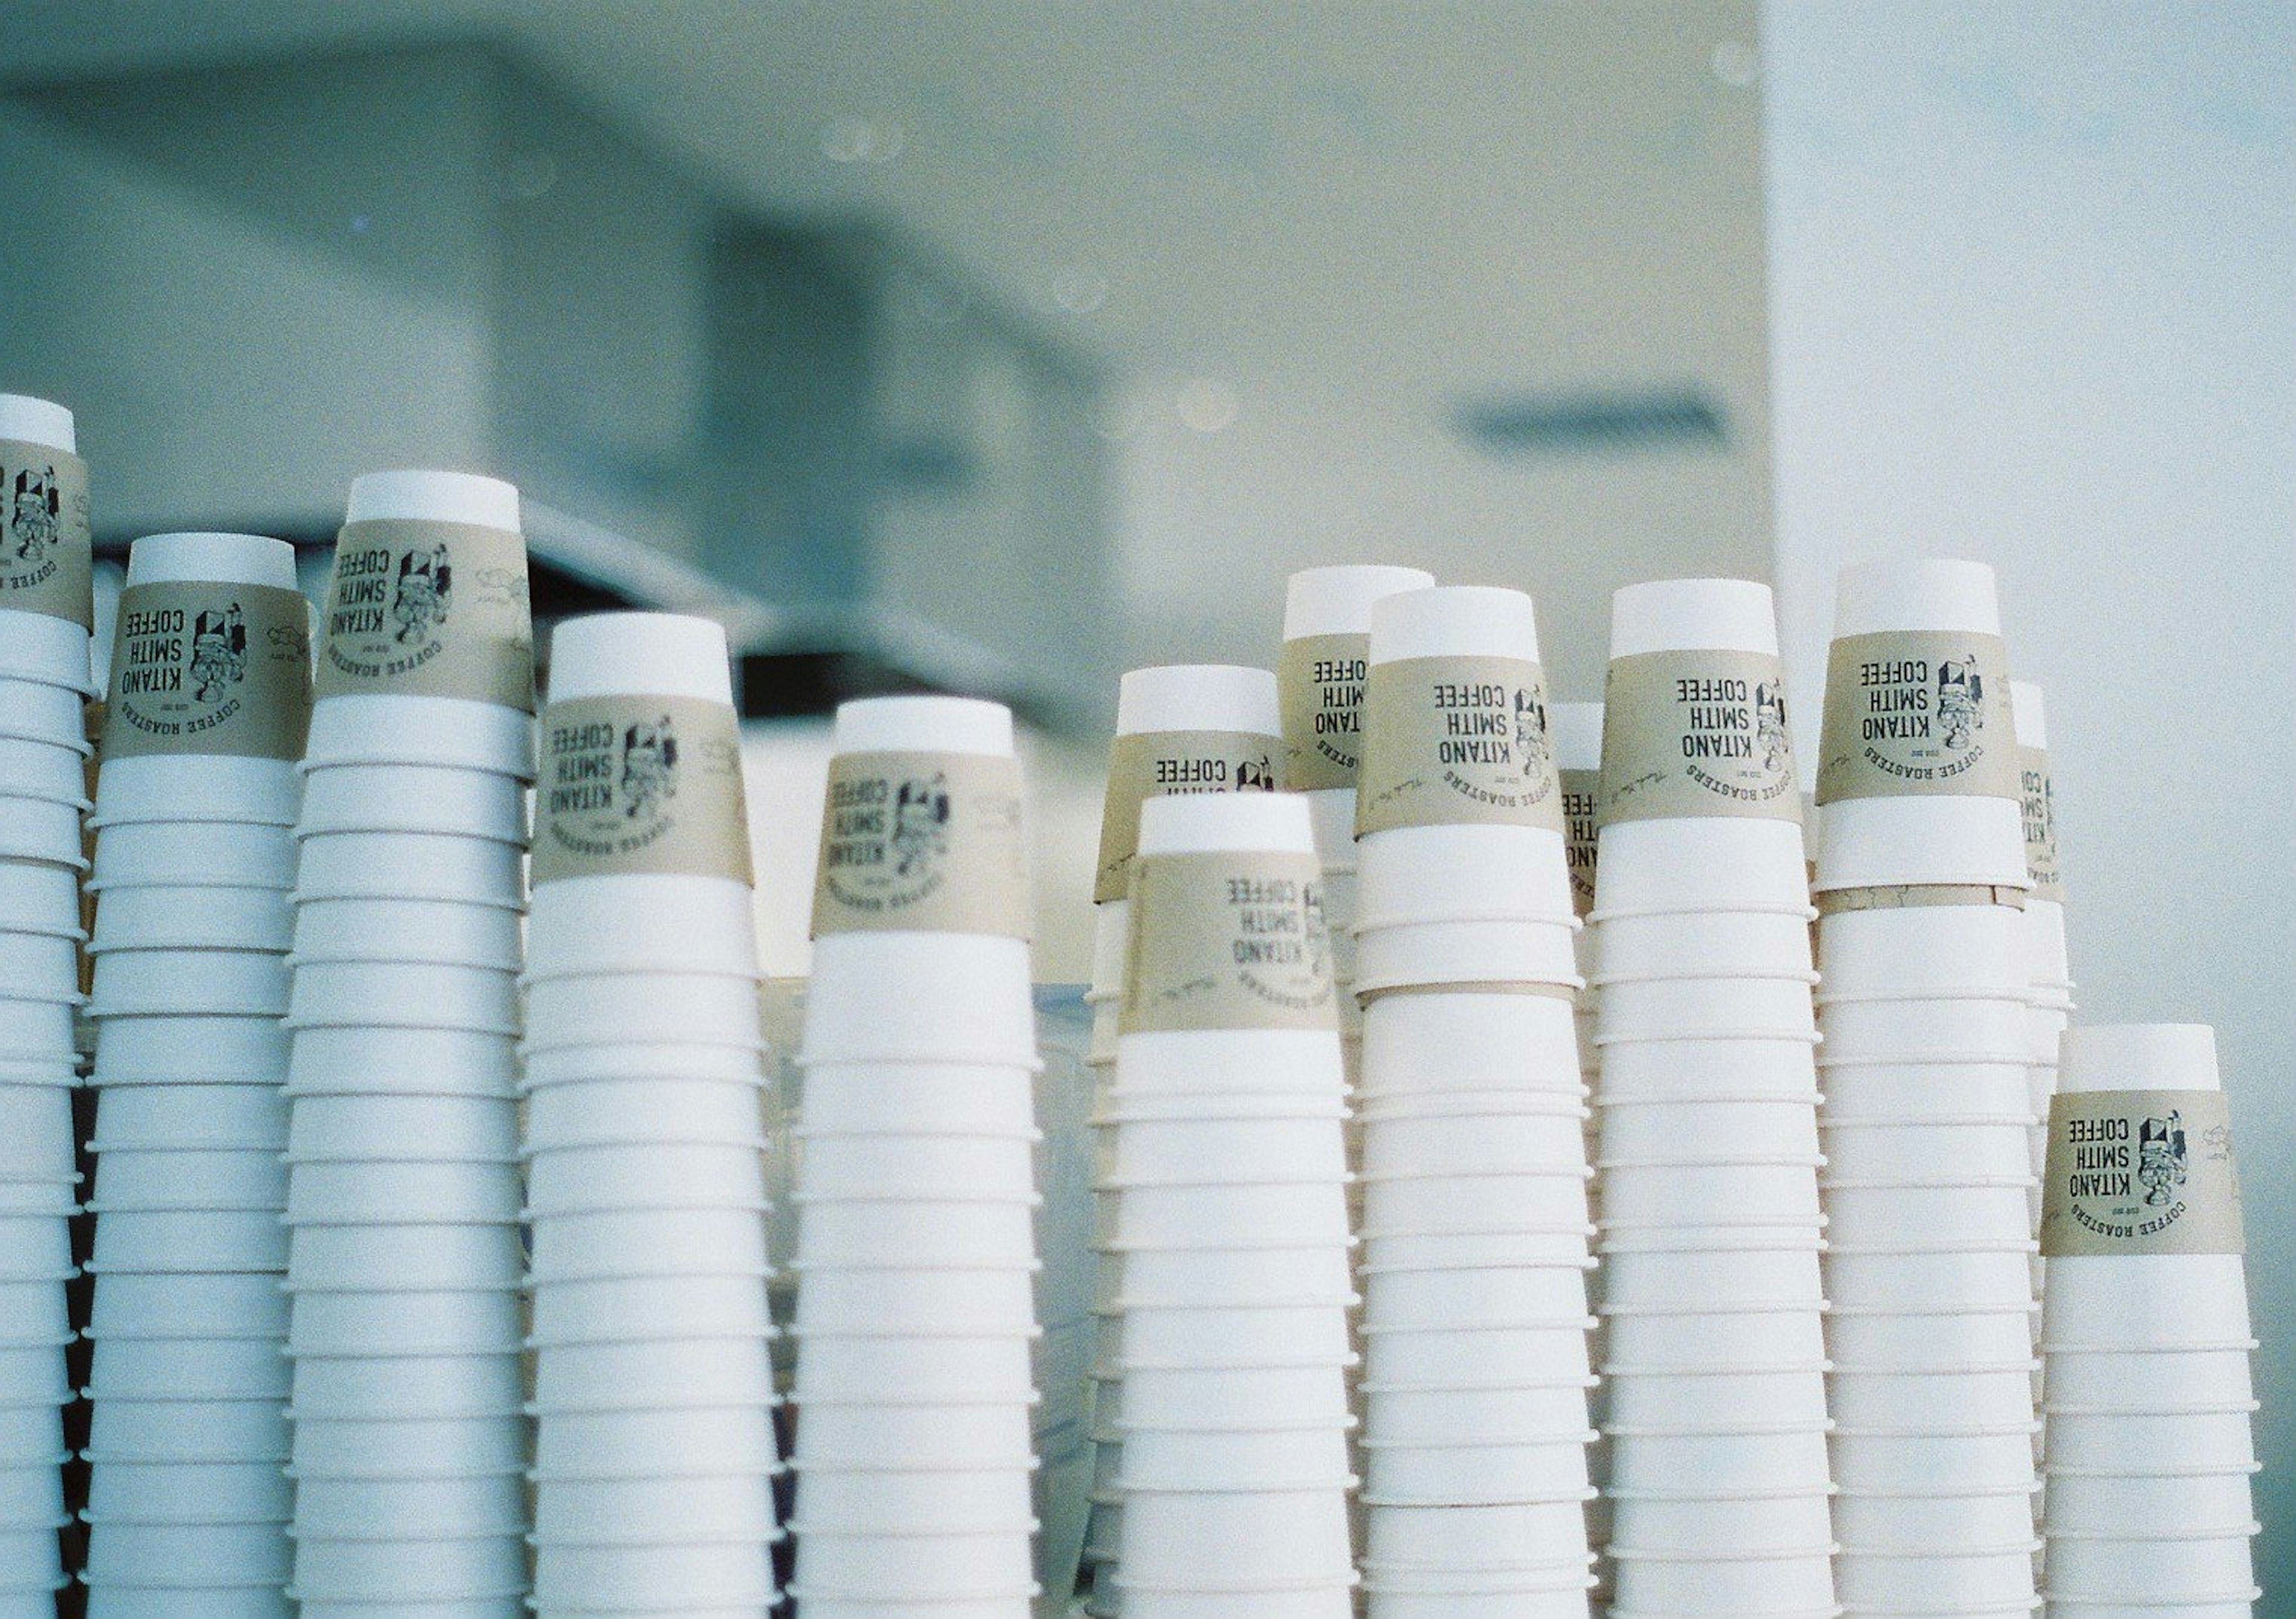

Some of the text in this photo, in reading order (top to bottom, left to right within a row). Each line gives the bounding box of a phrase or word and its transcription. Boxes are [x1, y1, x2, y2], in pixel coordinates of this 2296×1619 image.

[10, 561, 57, 589] COFFEE
[339, 550, 389, 578] COFFEE
[339, 580, 386, 605] SMITH
[127, 610, 184, 637] COFFEE
[330, 609, 384, 636] KITANO
[130, 640, 183, 664] SMITH
[123, 668, 181, 694] KITANO
[1314, 660, 1366, 682] OFFEE
[1861, 661, 1928, 686] COFFEE
[1323, 688, 1365, 707] MITH
[1434, 686, 1505, 708] COFFEE
[1677, 679, 1747, 702] COFFEE
[1870, 689, 1928, 712] SMITH
[123, 699, 240, 734] COFFEE ROASTERS
[1316, 713, 1360, 734] TANO
[1448, 713, 1507, 735] SMITH
[1690, 707, 1750, 729] SMITH
[1863, 716, 1929, 740] KITANO
[1317, 740, 1358, 768] STERS
[1440, 742, 1511, 763] KITANO
[1682, 735, 1752, 758] KITANO
[1156, 760, 1226, 783] COFFEE
[1865, 746, 1984, 779] COFFEE ROASTERS
[1444, 771, 1516, 807] ROASTERS
[1686, 765, 1757, 801] ROASTERS
[1562, 795, 1593, 815] FEE
[2069, 1119, 2129, 1143] COFFEE
[2077, 1146, 2129, 1169] SMITH
[2069, 1172, 2130, 1196] KITANO
[2071, 1200, 2187, 1238] COFFEE ROASTERS
